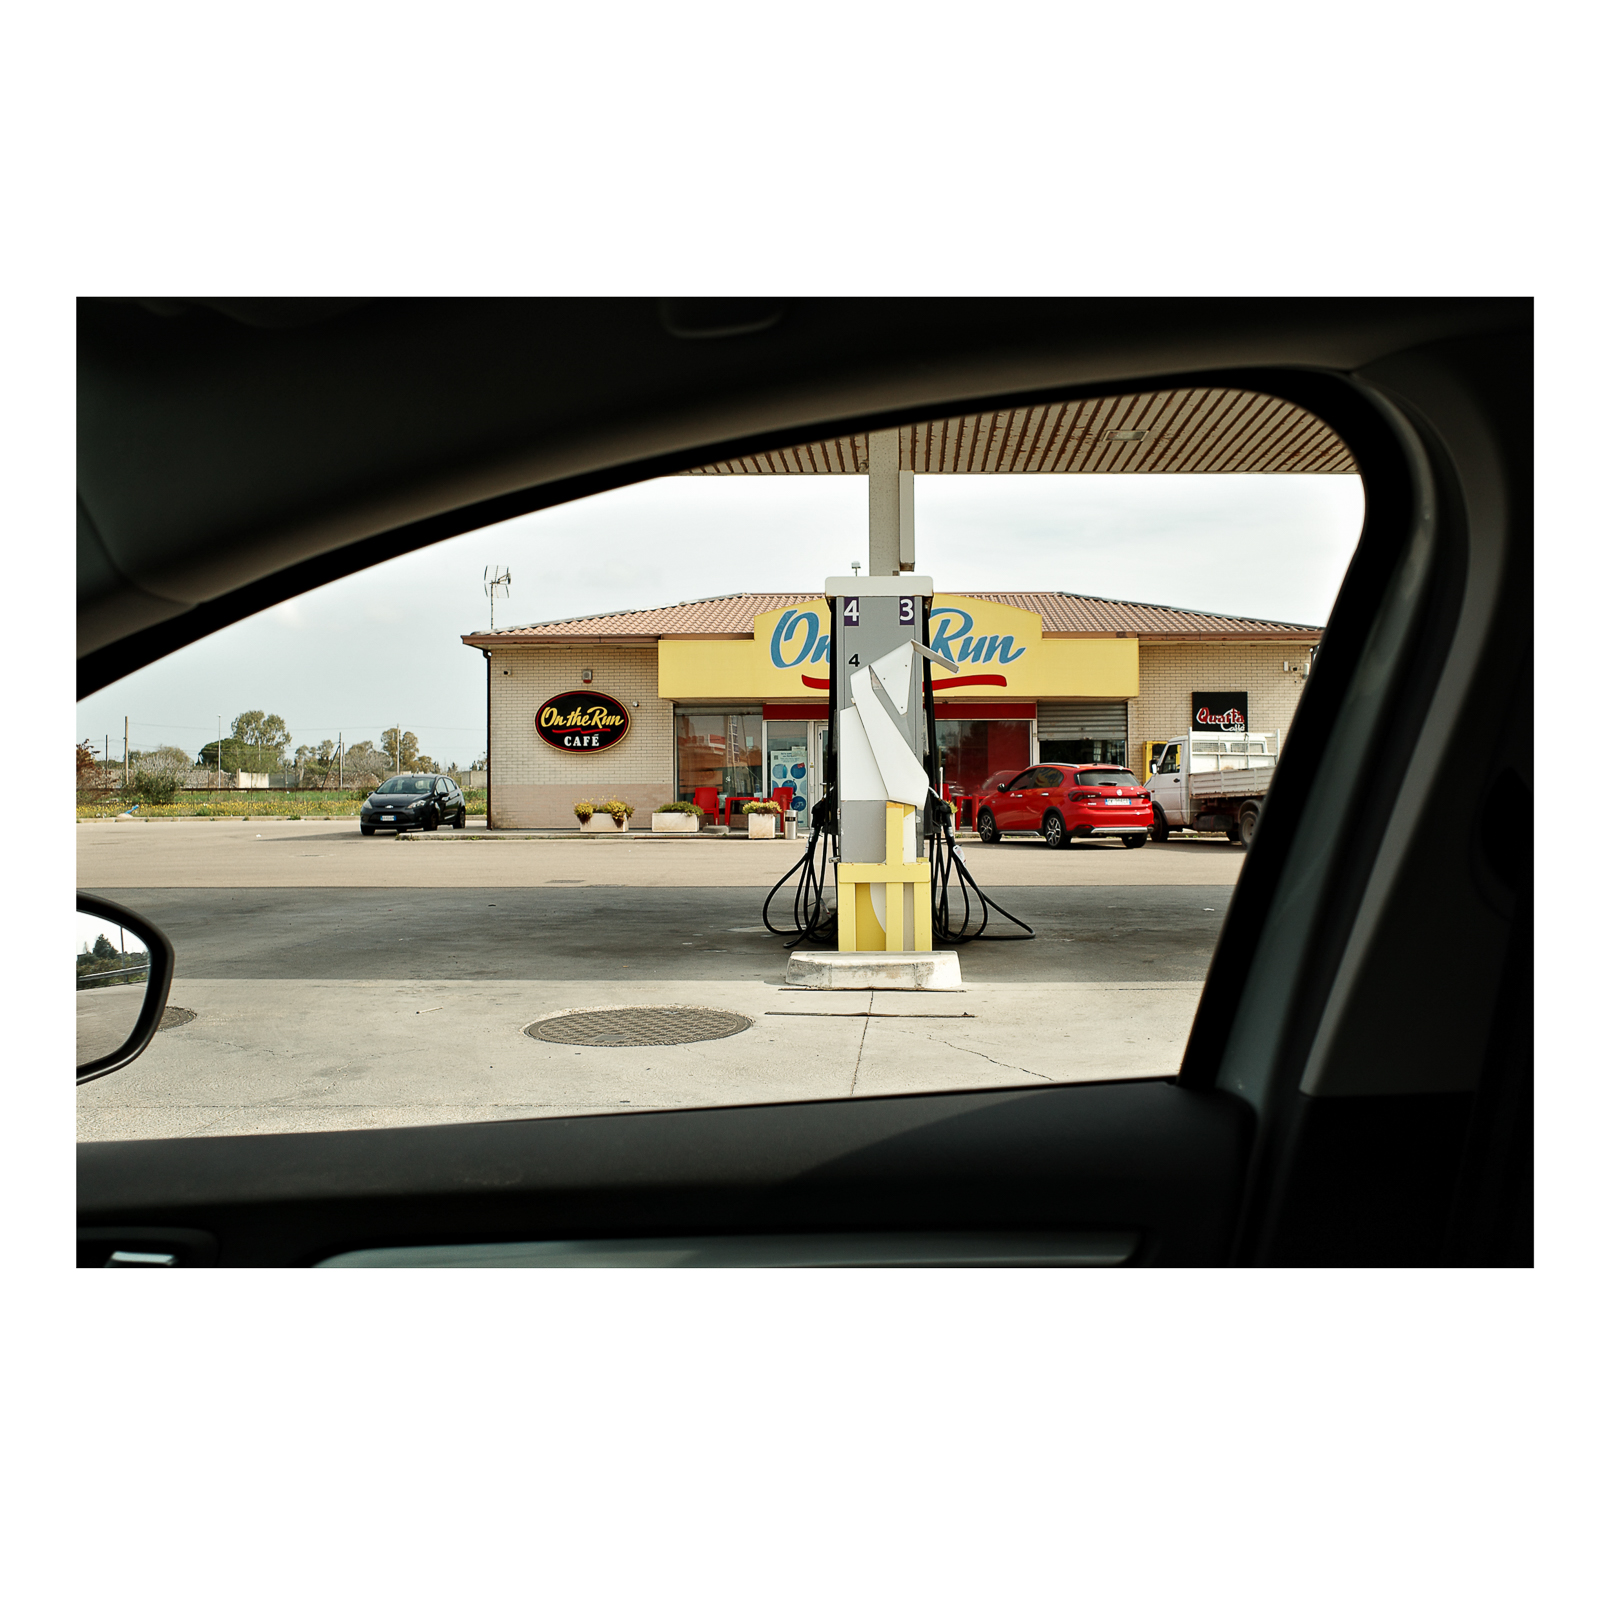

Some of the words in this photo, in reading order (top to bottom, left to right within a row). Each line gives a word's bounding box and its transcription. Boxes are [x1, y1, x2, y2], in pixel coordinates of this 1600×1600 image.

[844, 600, 859, 621] 4
[900, 599, 914, 620] 3
[930, 607, 1026, 664] Run
[848, 653, 860, 667] 4
[541, 706, 566, 728] On
[566, 706, 591, 727] the
[587, 706, 625, 729] Run
[1196, 707, 1245, 724] Quarta
[564, 733, 600, 747] CAFÉ
